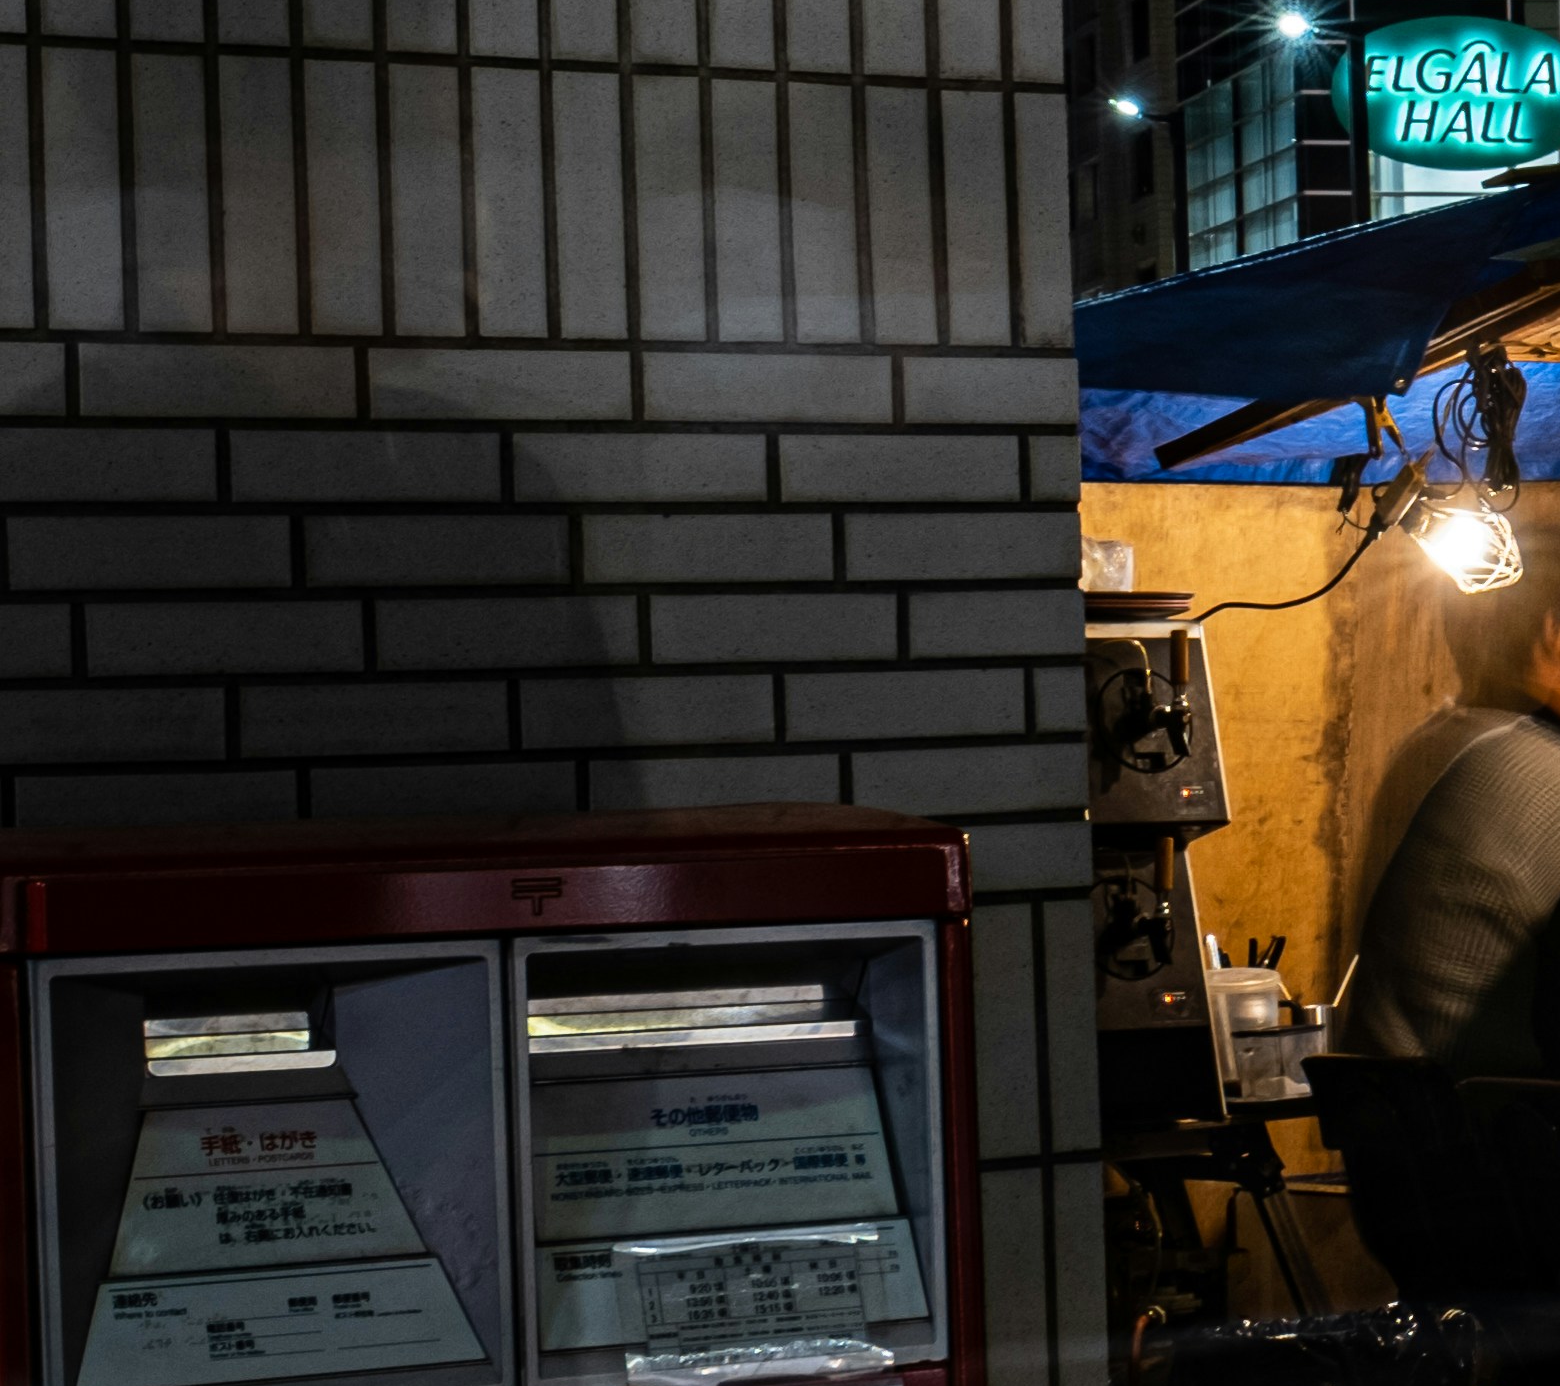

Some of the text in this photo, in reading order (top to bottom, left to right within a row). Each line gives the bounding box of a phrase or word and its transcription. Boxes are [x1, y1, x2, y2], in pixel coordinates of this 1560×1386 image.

[1400, 101, 1533, 143] HALL
[650, 1102, 759, 1128] その他郵便物
[201, 1129, 318, 1156] 手紙・はがき
[688, 1126, 729, 1137] OTHERS
[113, 1293, 158, 1310] 連絡先
